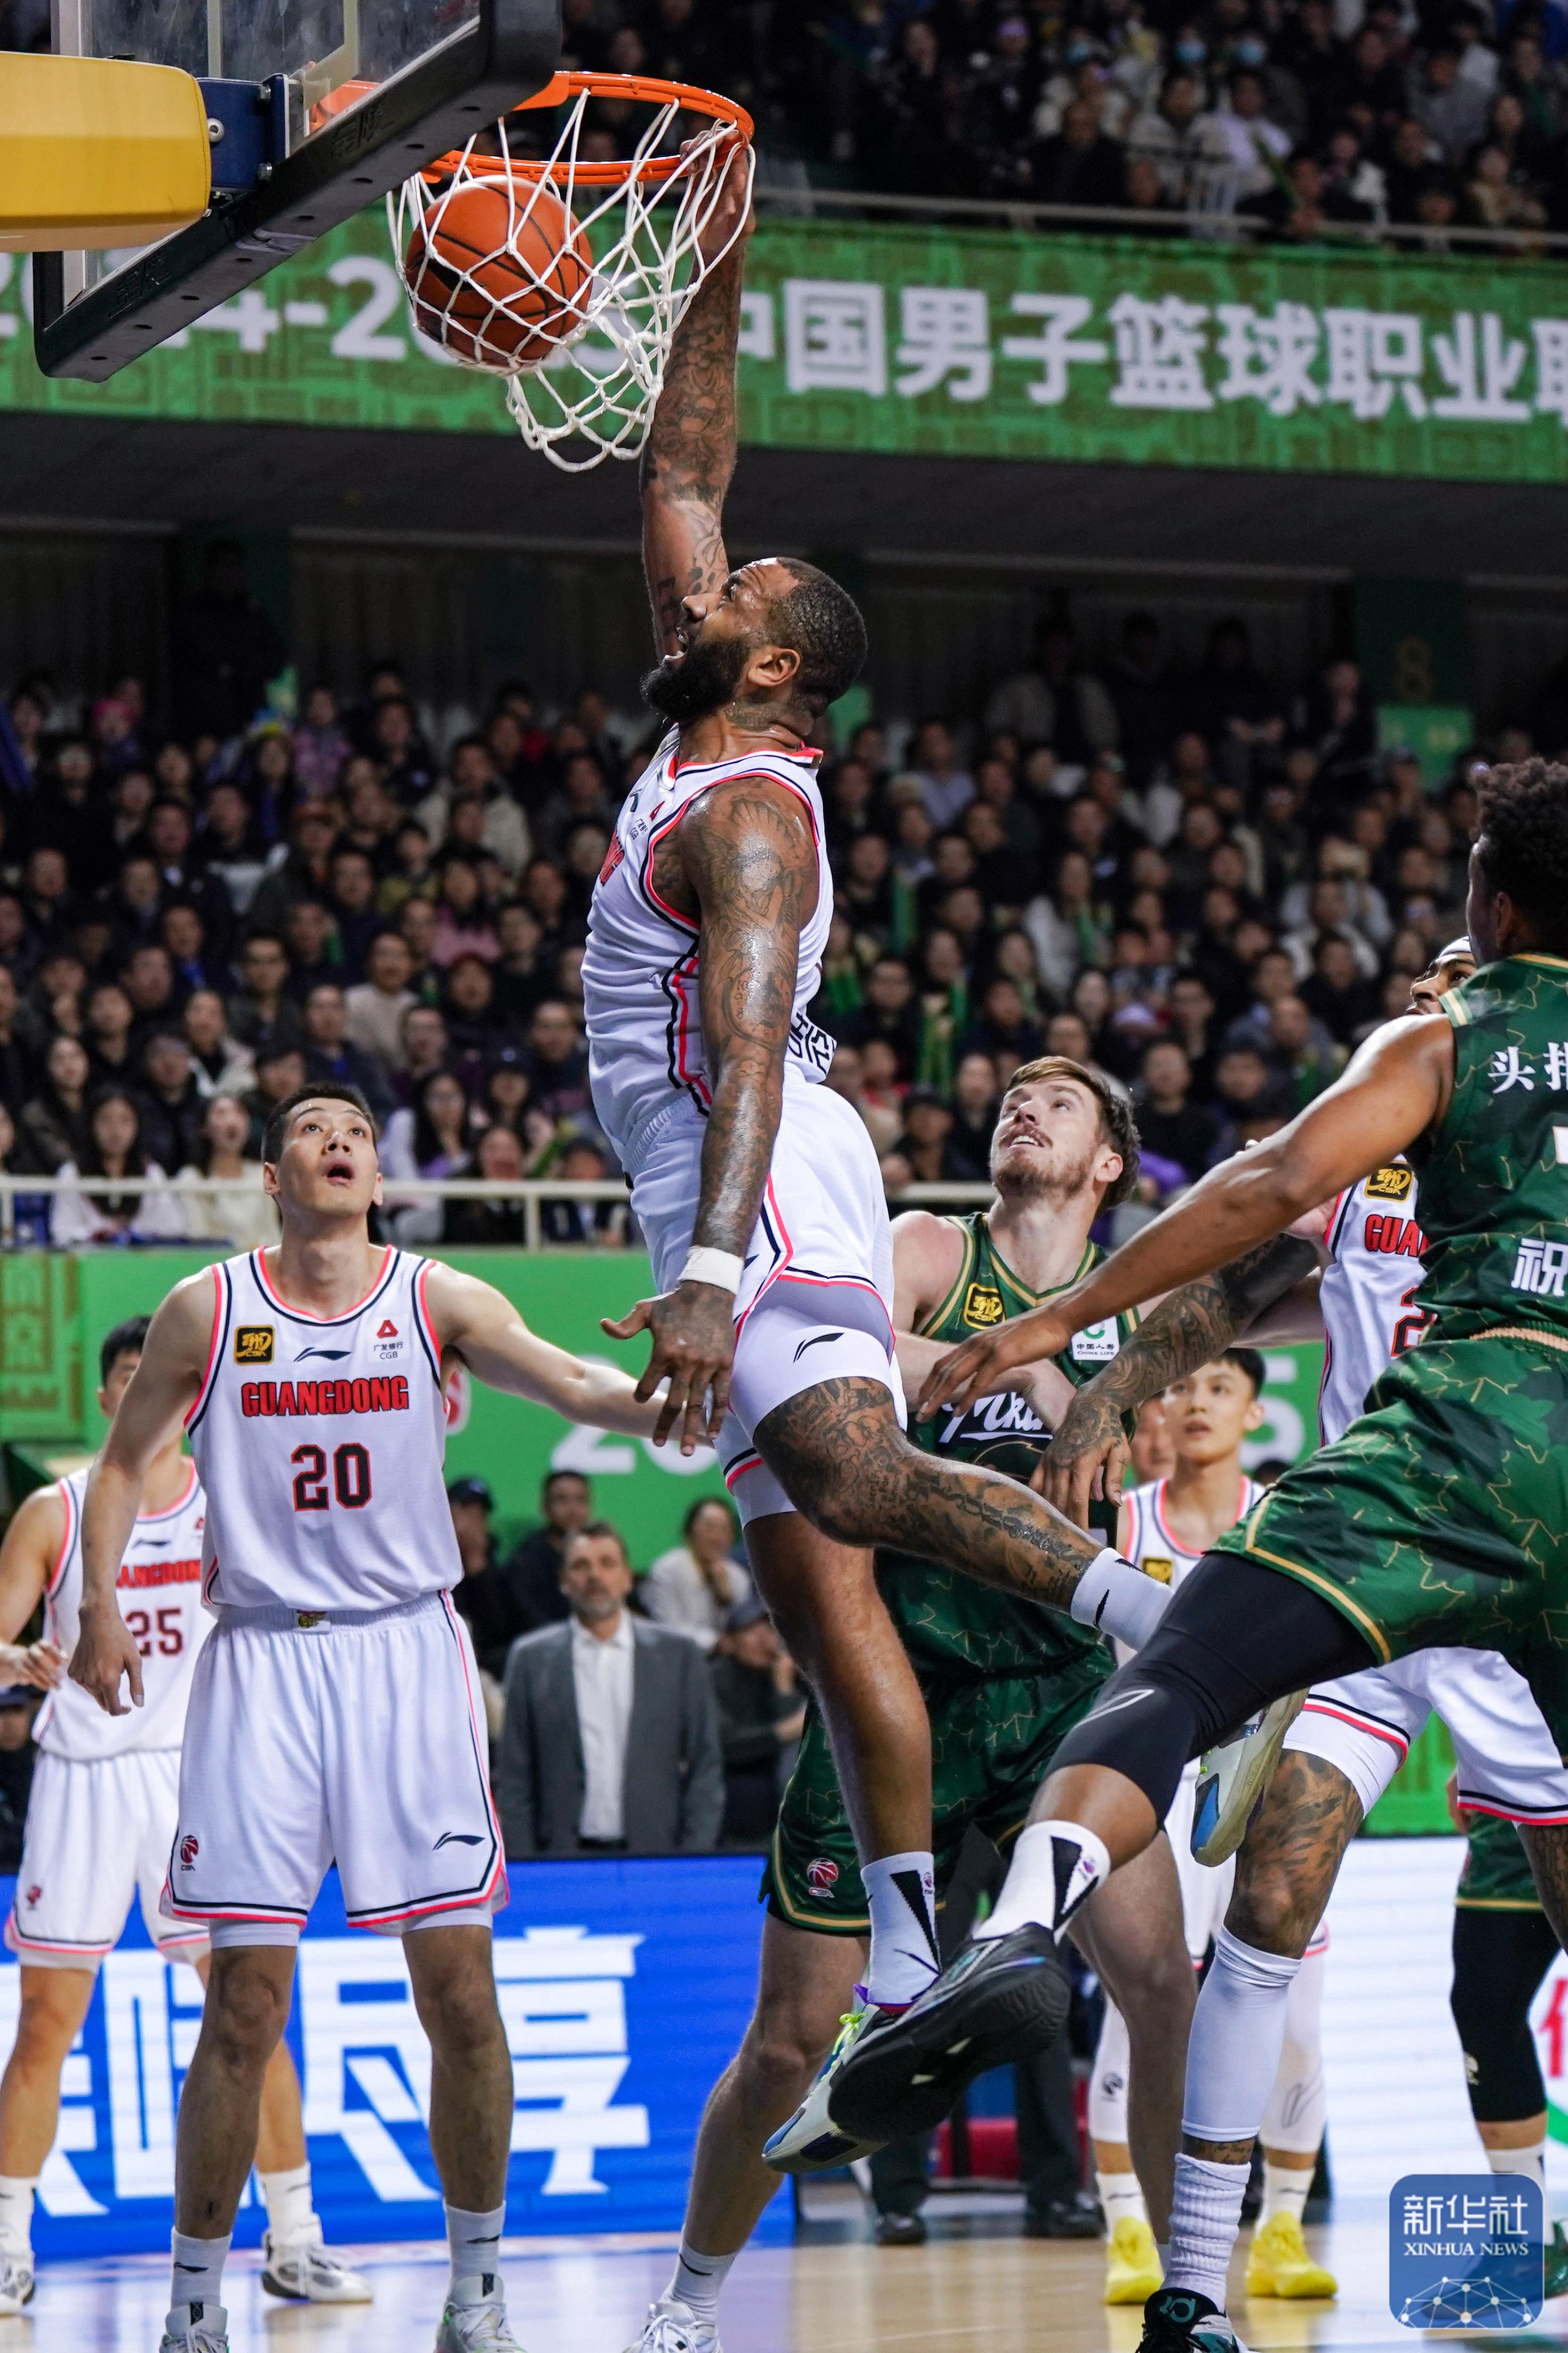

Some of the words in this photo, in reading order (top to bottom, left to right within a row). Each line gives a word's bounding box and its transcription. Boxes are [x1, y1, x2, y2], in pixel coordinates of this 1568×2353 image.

[241, 1375, 410, 1417] GUANGDONG
[290, 1442, 372, 1512] 20
[125, 1607, 184, 1657] 25
